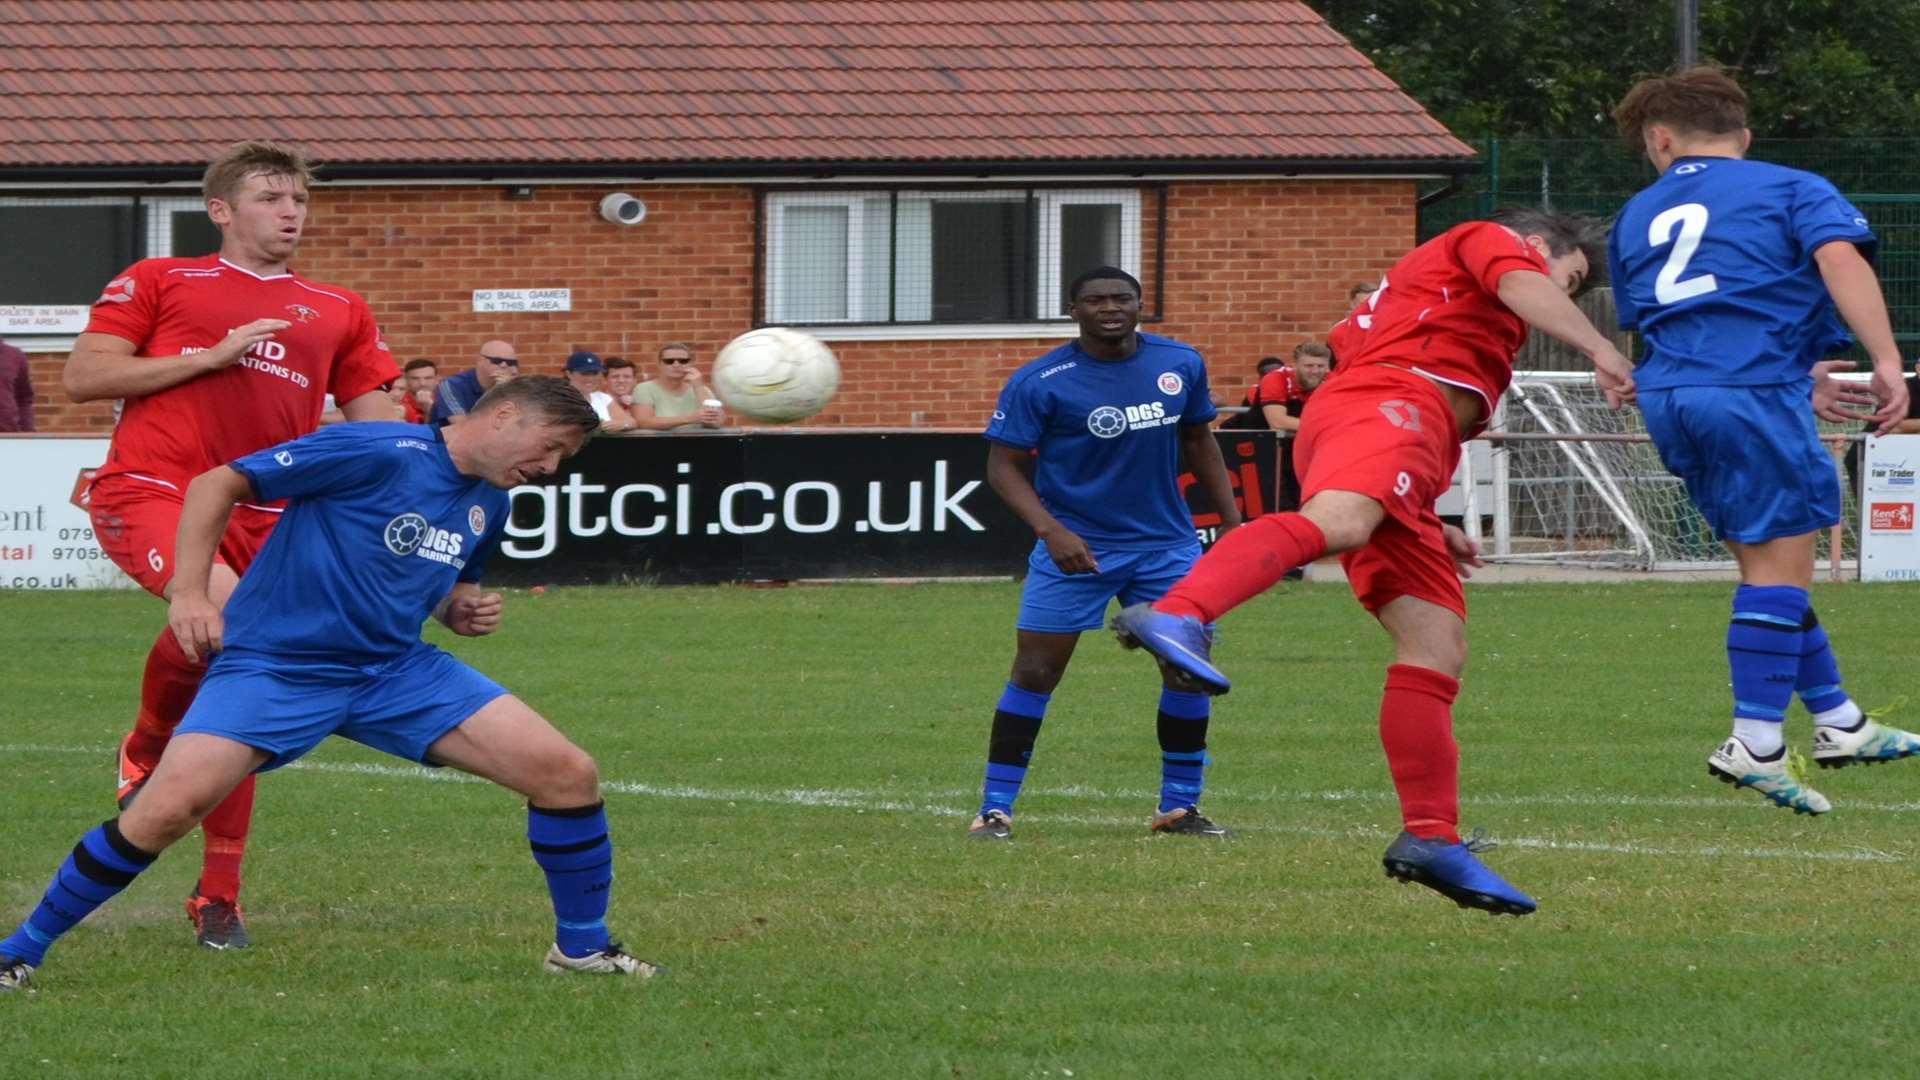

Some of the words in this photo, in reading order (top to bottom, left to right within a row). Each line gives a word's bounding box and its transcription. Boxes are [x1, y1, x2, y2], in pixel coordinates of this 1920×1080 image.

[1648, 203, 1719, 305] 2
[476, 291, 492, 300] NO
[497, 291, 522, 300] BALL
[528, 290, 567, 299] GAMES
[483, 302, 494, 310] IN
[500, 301, 524, 310] THIS
[530, 300, 559, 309] AREA
[1124, 401, 1165, 423] DGS
[1393, 471, 1411, 496] 9
[500, 460, 986, 560] gtci.co.uk
[147, 548, 164, 573] 6
[0, 573, 78, 588] .co.uk
